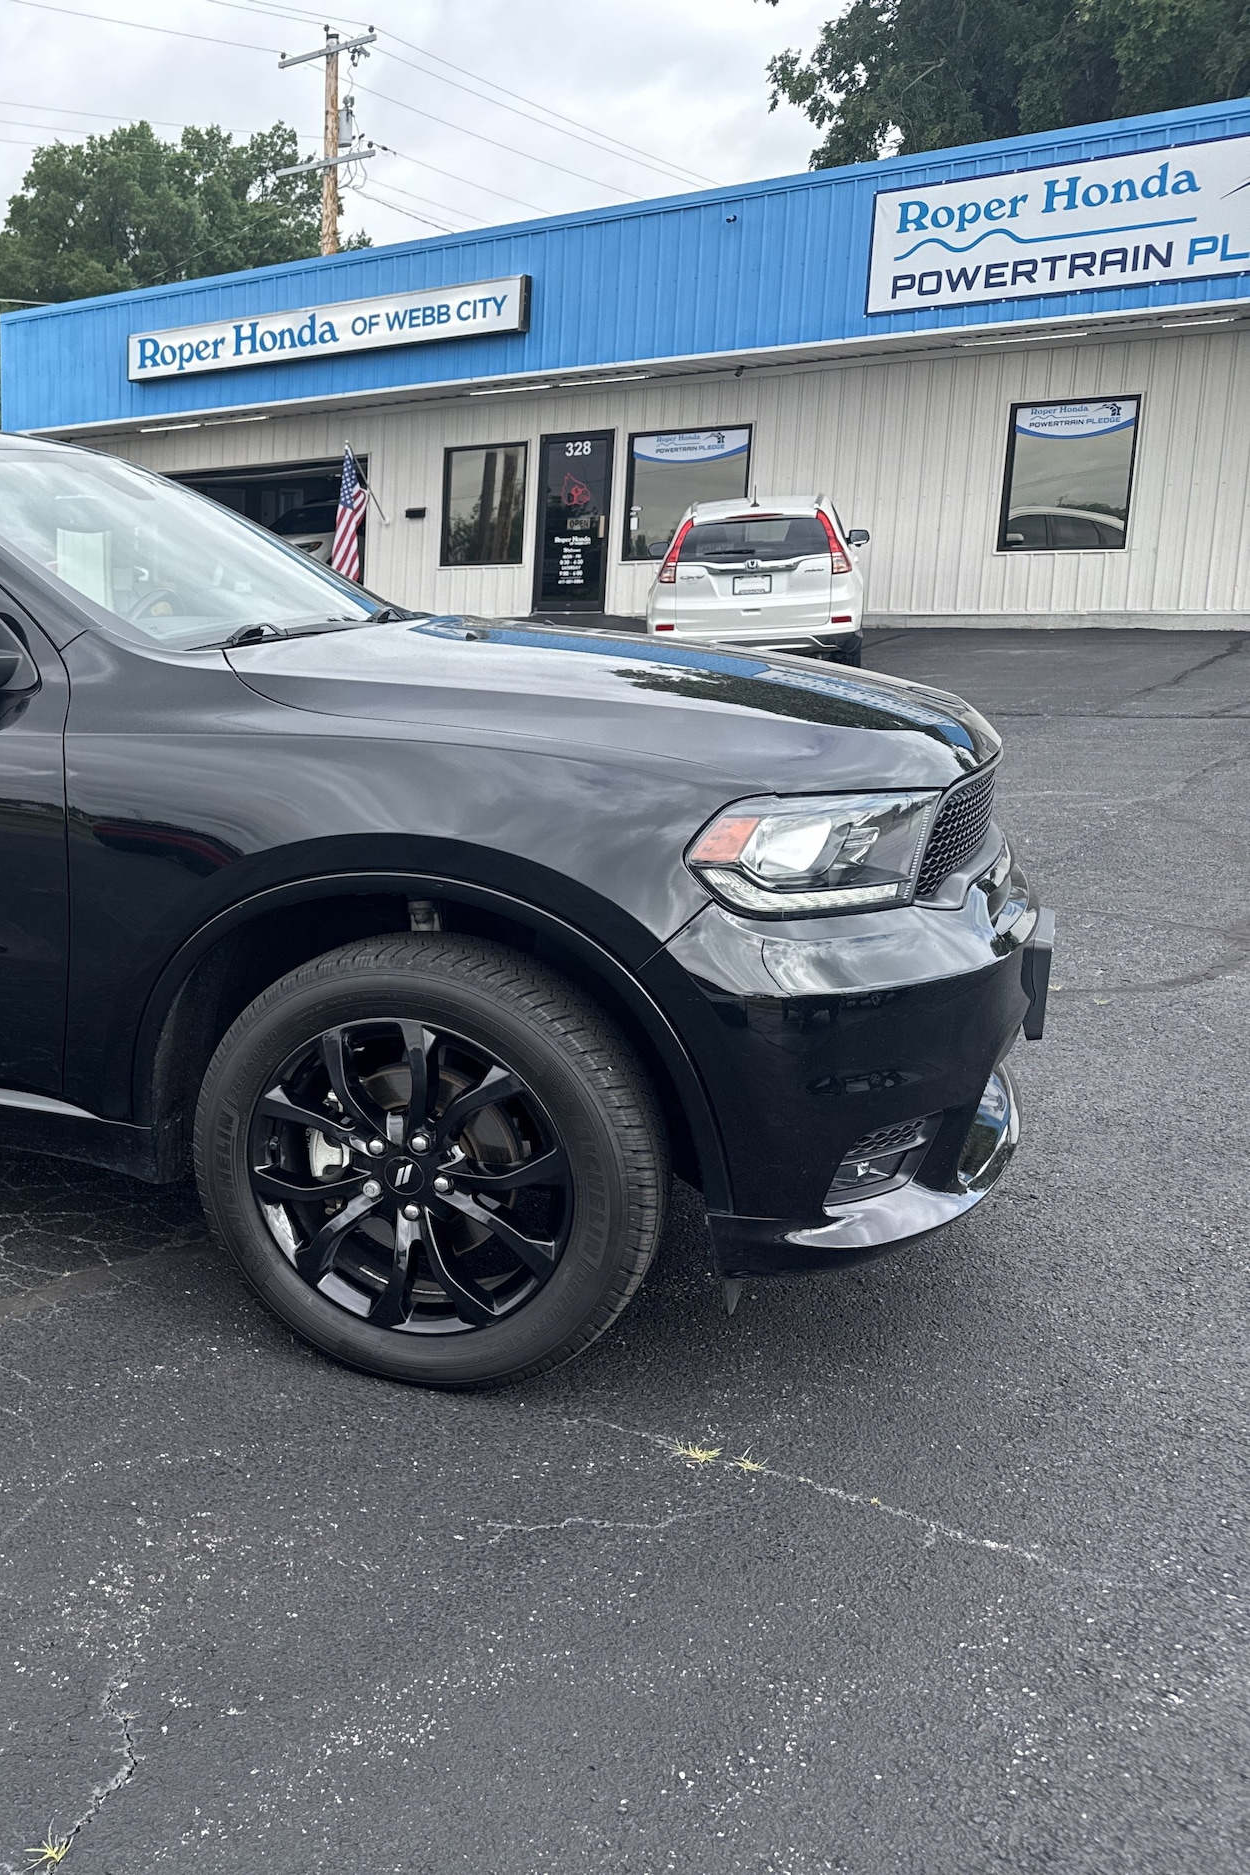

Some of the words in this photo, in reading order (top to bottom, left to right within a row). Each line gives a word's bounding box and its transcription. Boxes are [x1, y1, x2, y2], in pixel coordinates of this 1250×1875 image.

[896, 193, 1029, 234] Roper
[1042, 161, 1201, 214] Honda
[890, 240, 1174, 300] POWERTRAIN
[137, 335, 225, 371] Roper
[232, 312, 340, 356] Honda
[350, 316, 381, 336] OF
[386, 303, 451, 330] WEBB
[456, 294, 509, 322] CITY
[1029, 419, 1085, 428] POWERTRAIN
[1085, 416, 1122, 425] PLEDGE
[1030, 407, 1057, 416] Roper
[1059, 404, 1089, 413] Honda
[565, 441, 592, 457] 328
[655, 446, 698, 454] POWERTRAIN
[214, 1107, 253, 1234] MICHELIN
[567, 1114, 608, 1261] MICHELIN
